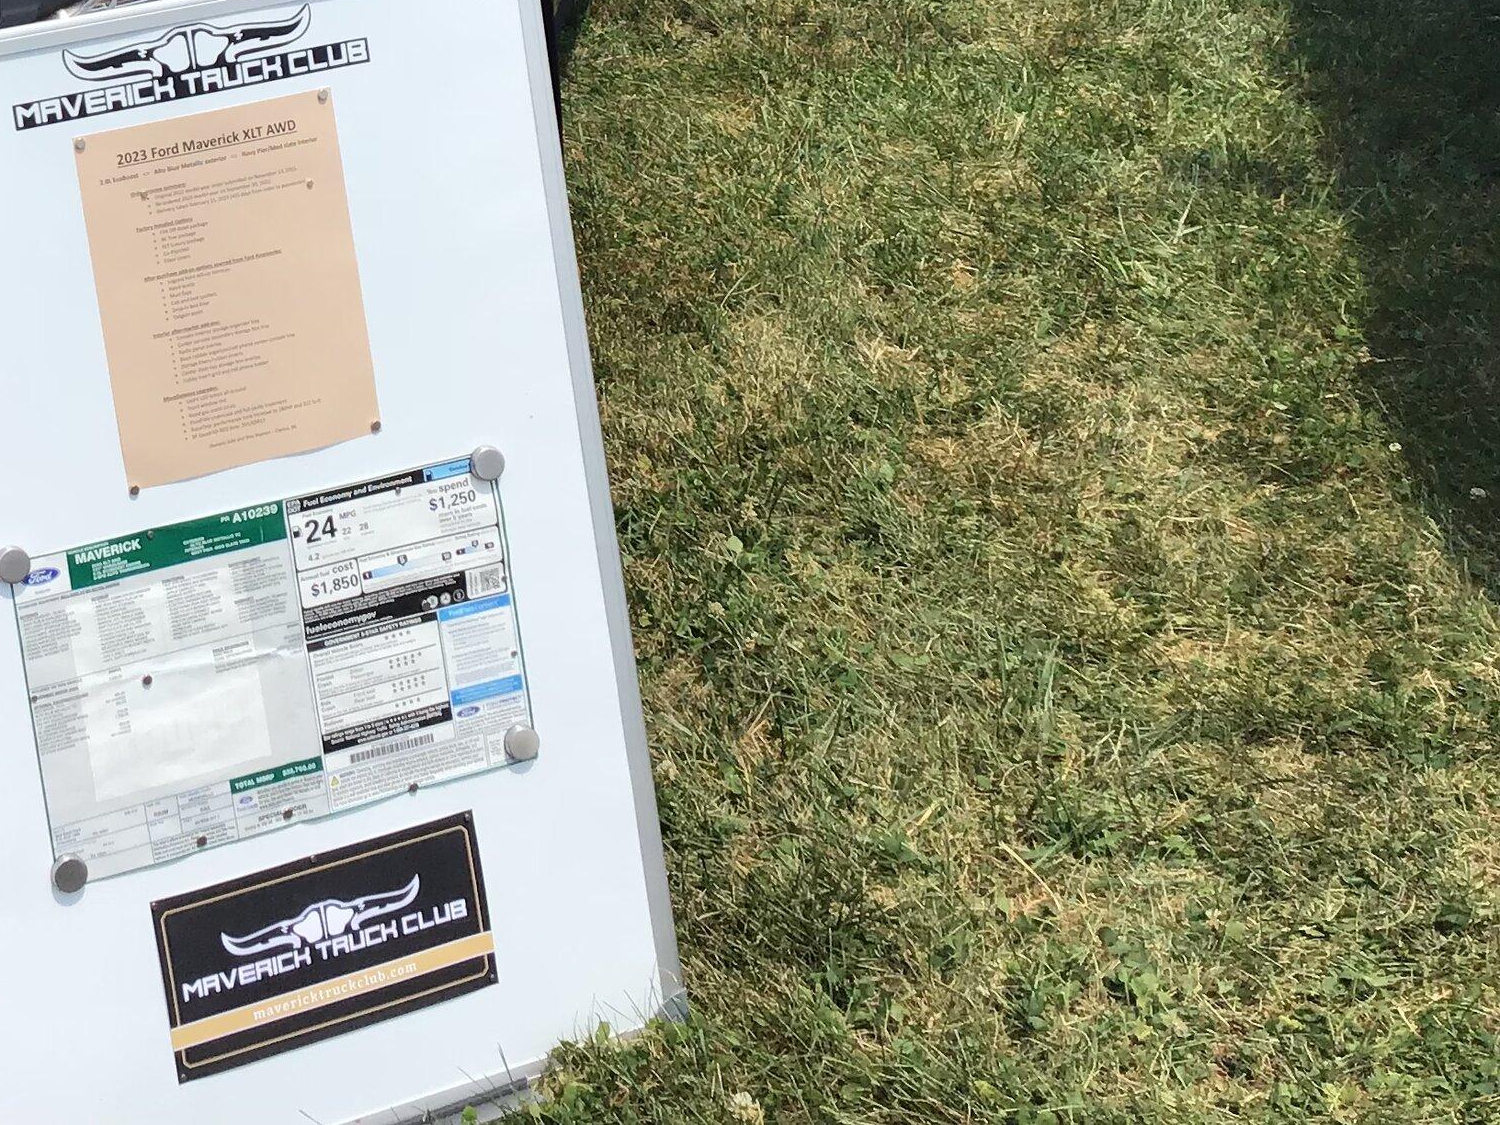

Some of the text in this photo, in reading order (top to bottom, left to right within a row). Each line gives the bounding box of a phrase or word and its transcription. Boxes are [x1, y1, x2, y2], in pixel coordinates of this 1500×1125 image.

[16, 39, 368, 127] MAVERICK TRUCK CLUB
[117, 119, 296, 166] 2023 Ford Maverick XLT AWD
[303, 498, 319, 508] Fuel
[320, 491, 353, 503] Economy
[354, 486, 367, 495] and
[368, 476, 413, 492] Environment
[439, 478, 469, 493] spend
[429, 489, 476, 511] $1,250
[232, 504, 278, 523] A10239
[339, 510, 356, 520] MPG
[304, 515, 337, 543] 24
[75, 539, 141, 564] MAVERICK
[332, 561, 354, 574] cost
[311, 574, 359, 597] $1,850
[380, 623, 399, 633] SAFETY
[234, 778, 255, 790] TOTAL
[182, 899, 468, 1003] MAVERICK TRUCK CLUB
[253, 962, 417, 1021] mavericktruckclub.com
